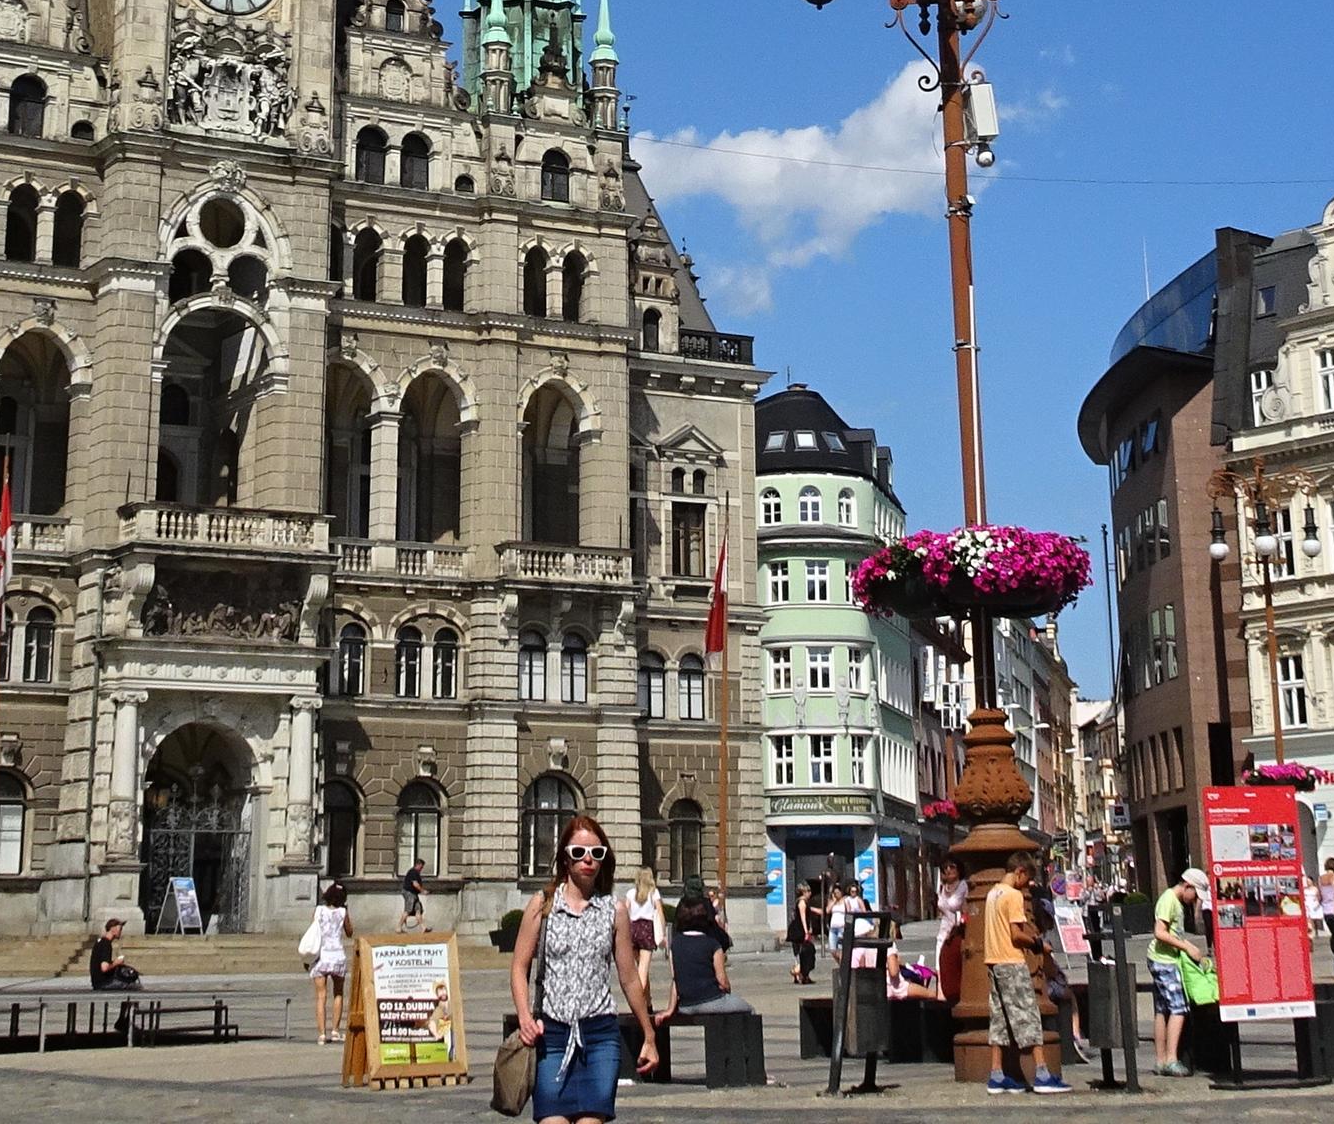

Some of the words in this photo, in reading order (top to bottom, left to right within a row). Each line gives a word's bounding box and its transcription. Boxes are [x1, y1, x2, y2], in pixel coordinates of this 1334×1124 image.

[375, 948, 422, 958] FARMÁŘSKÉ
[424, 948, 444, 957] TRHY
[395, 957, 433, 967] KOSTELNÍ
[379, 1002, 393, 1011] OD
[406, 1001, 435, 1011] DUBNA
[381, 1028, 391, 1036] od
[408, 1027, 430, 1036] hodin
